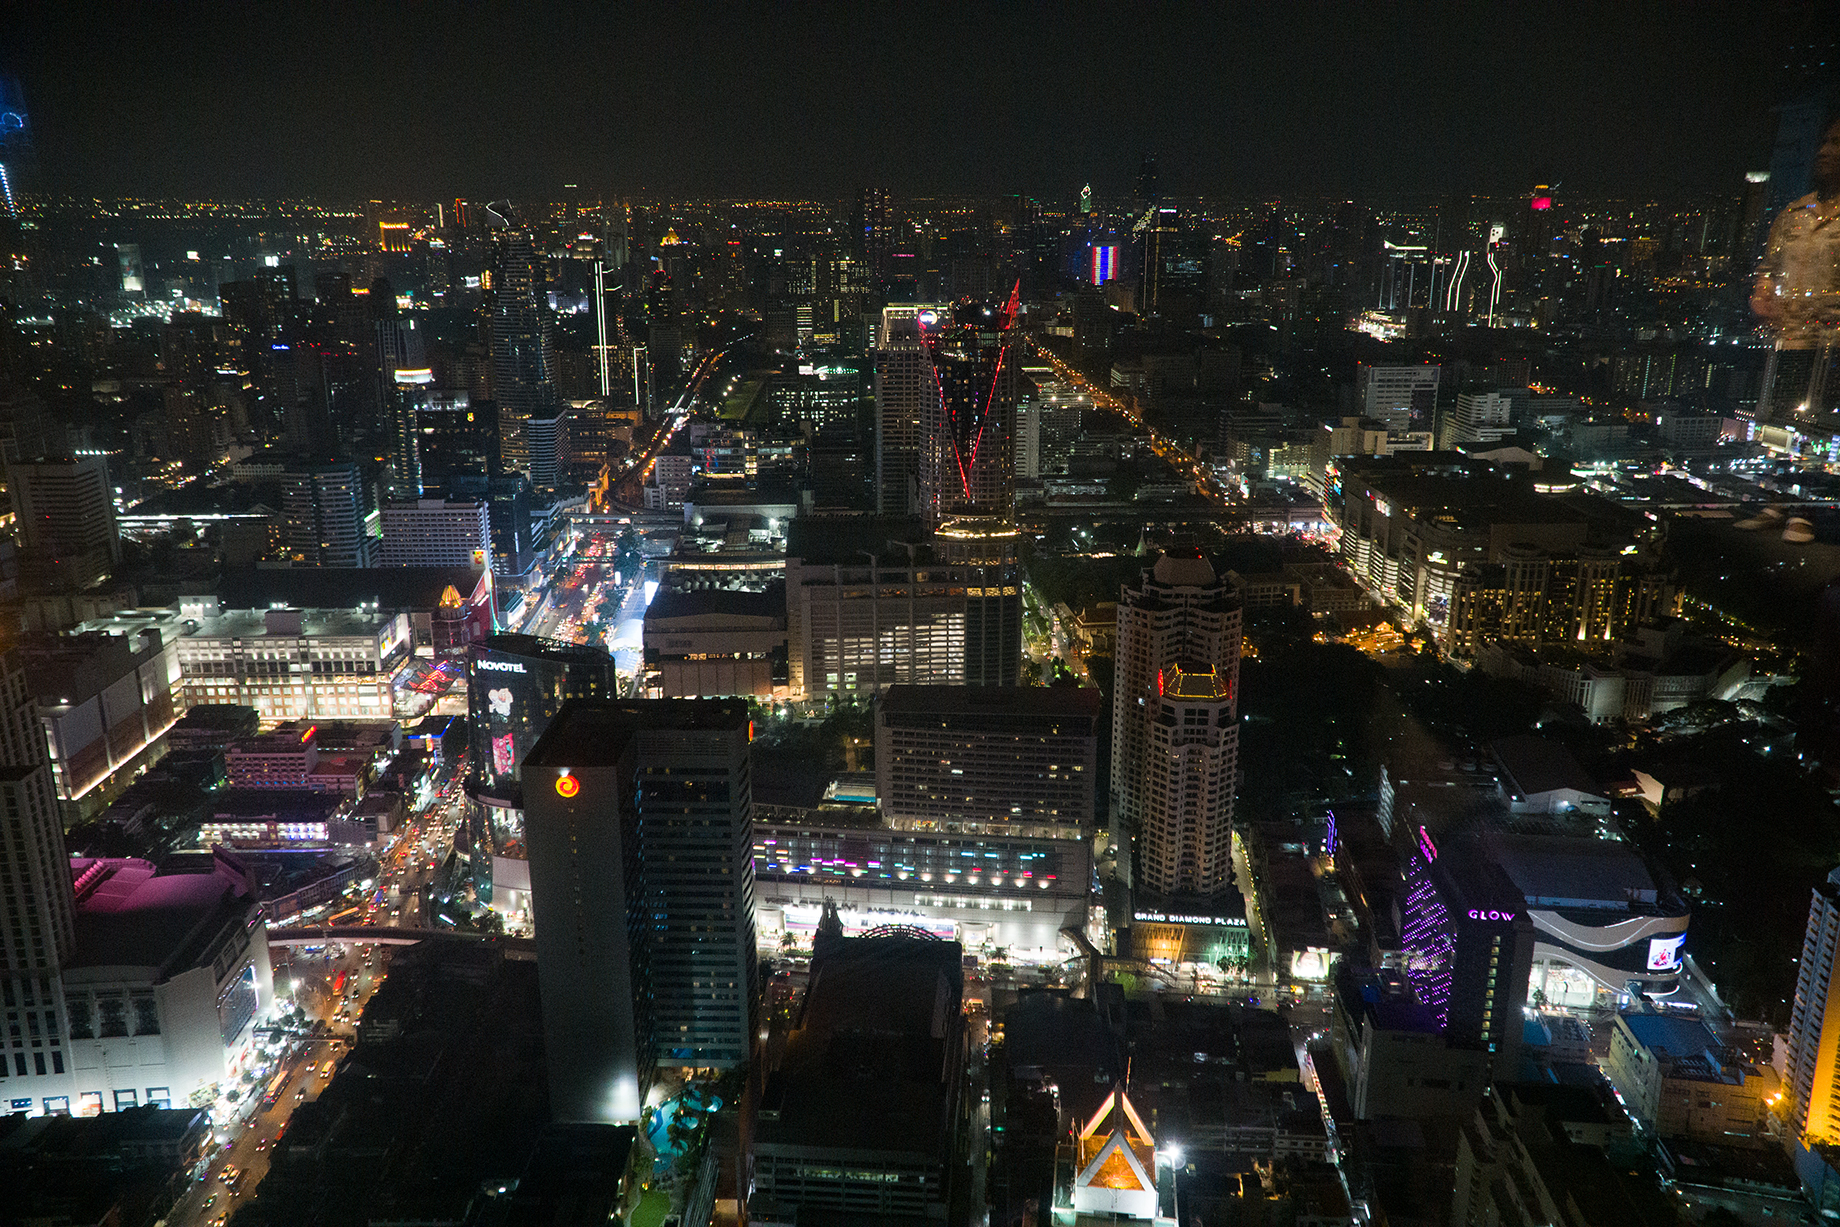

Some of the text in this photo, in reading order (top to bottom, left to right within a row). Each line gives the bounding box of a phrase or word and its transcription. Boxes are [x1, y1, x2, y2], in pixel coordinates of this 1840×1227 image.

[477, 659, 527, 673] NOVOTEL
[1134, 912, 1247, 926] GRAND DIAMOND PLAZA
[1468, 909, 1515, 921] GLOW
